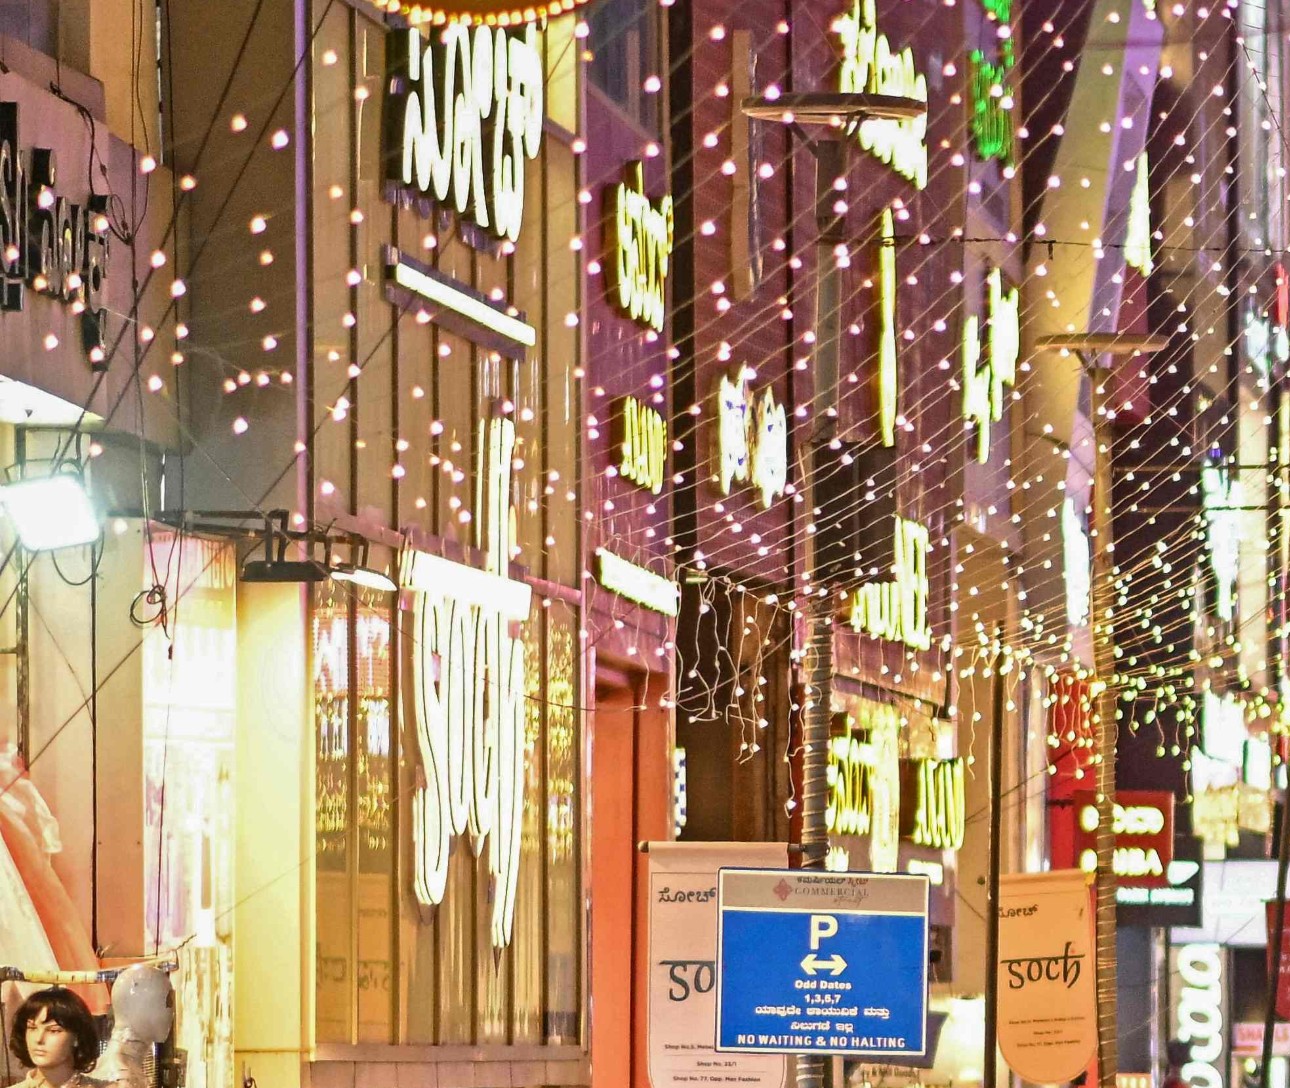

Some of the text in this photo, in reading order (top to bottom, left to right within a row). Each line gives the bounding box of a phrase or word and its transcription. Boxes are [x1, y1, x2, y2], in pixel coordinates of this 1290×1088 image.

[795, 887, 869, 897] COMMERCIAL
[810, 914, 838, 950] P
[1000, 941, 1085, 989] soch
[659, 960, 716, 1002] so
[795, 979, 852, 990] Odd Dates
[737, 1034, 905, 1048] NO WAITING & NO HALTING
